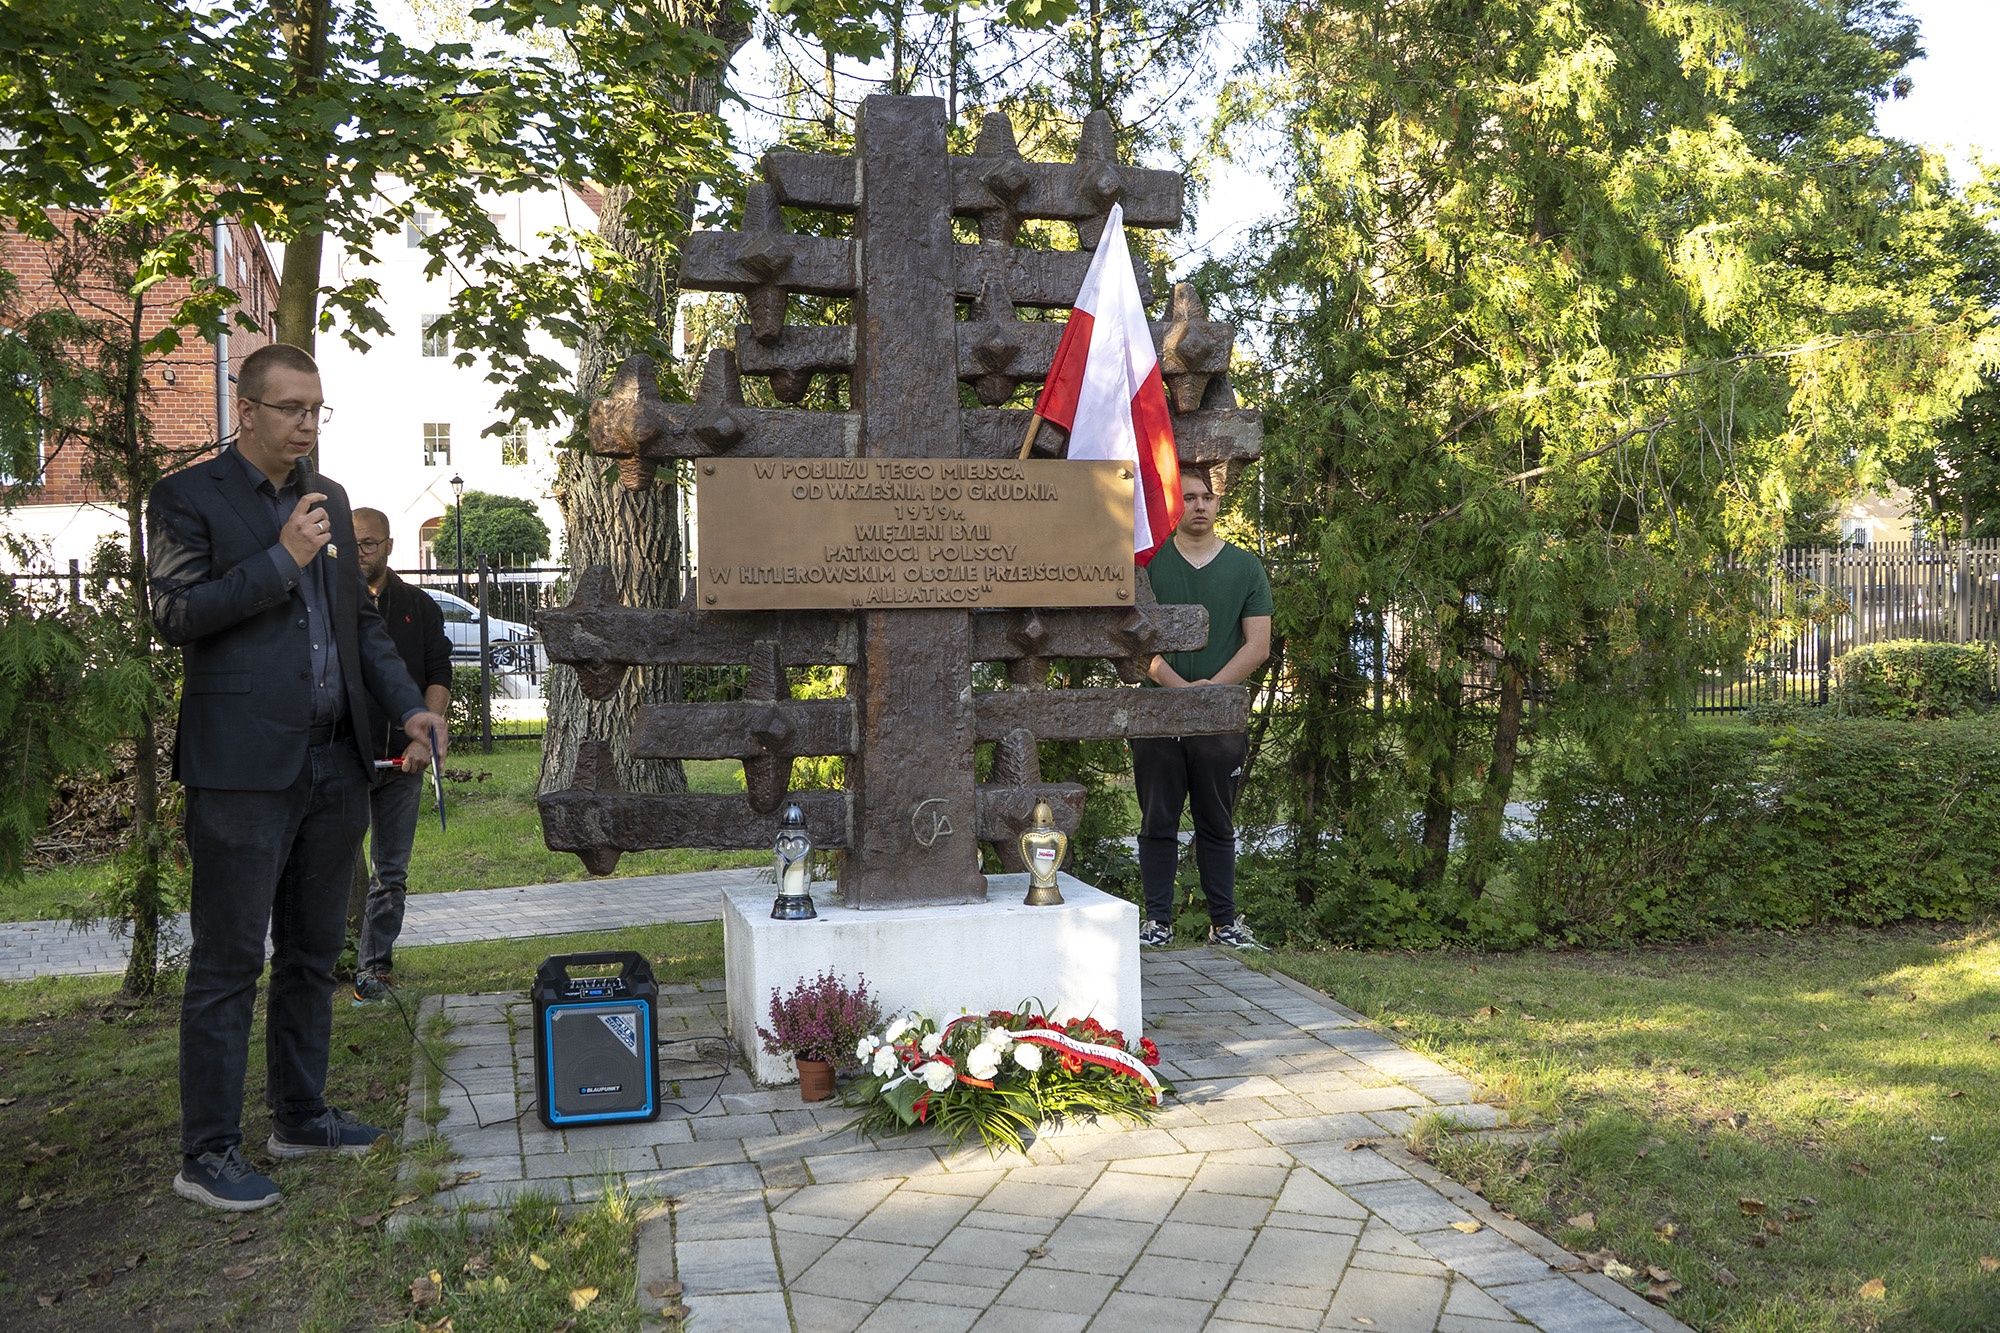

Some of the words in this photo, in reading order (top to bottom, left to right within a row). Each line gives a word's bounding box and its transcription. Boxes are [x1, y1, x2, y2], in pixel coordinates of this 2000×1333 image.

[754, 462, 776, 480] W
[782, 459, 869, 480] POBLIŻU
[876, 462, 934, 480] TEGO
[941, 463, 1025, 480] MIEJSCA
[792, 483, 823, 500] OD
[827, 481, 925, 501] WRZEŚNIA
[931, 484, 963, 501] DO
[968, 482, 1058, 501] GRUDNIA
[855, 523, 943, 544] WIĘZIENI
[951, 523, 992, 541] BYLI
[825, 545, 919, 562] PATRIOCI
[928, 544, 1017, 561] POLSCY
[709, 566, 732, 584] W
[739, 565, 896, 585] HITLEROWSKIM
[904, 565, 978, 583] OBOZIE
[984, 562, 1124, 583] PRZEJŚCIOWYM
